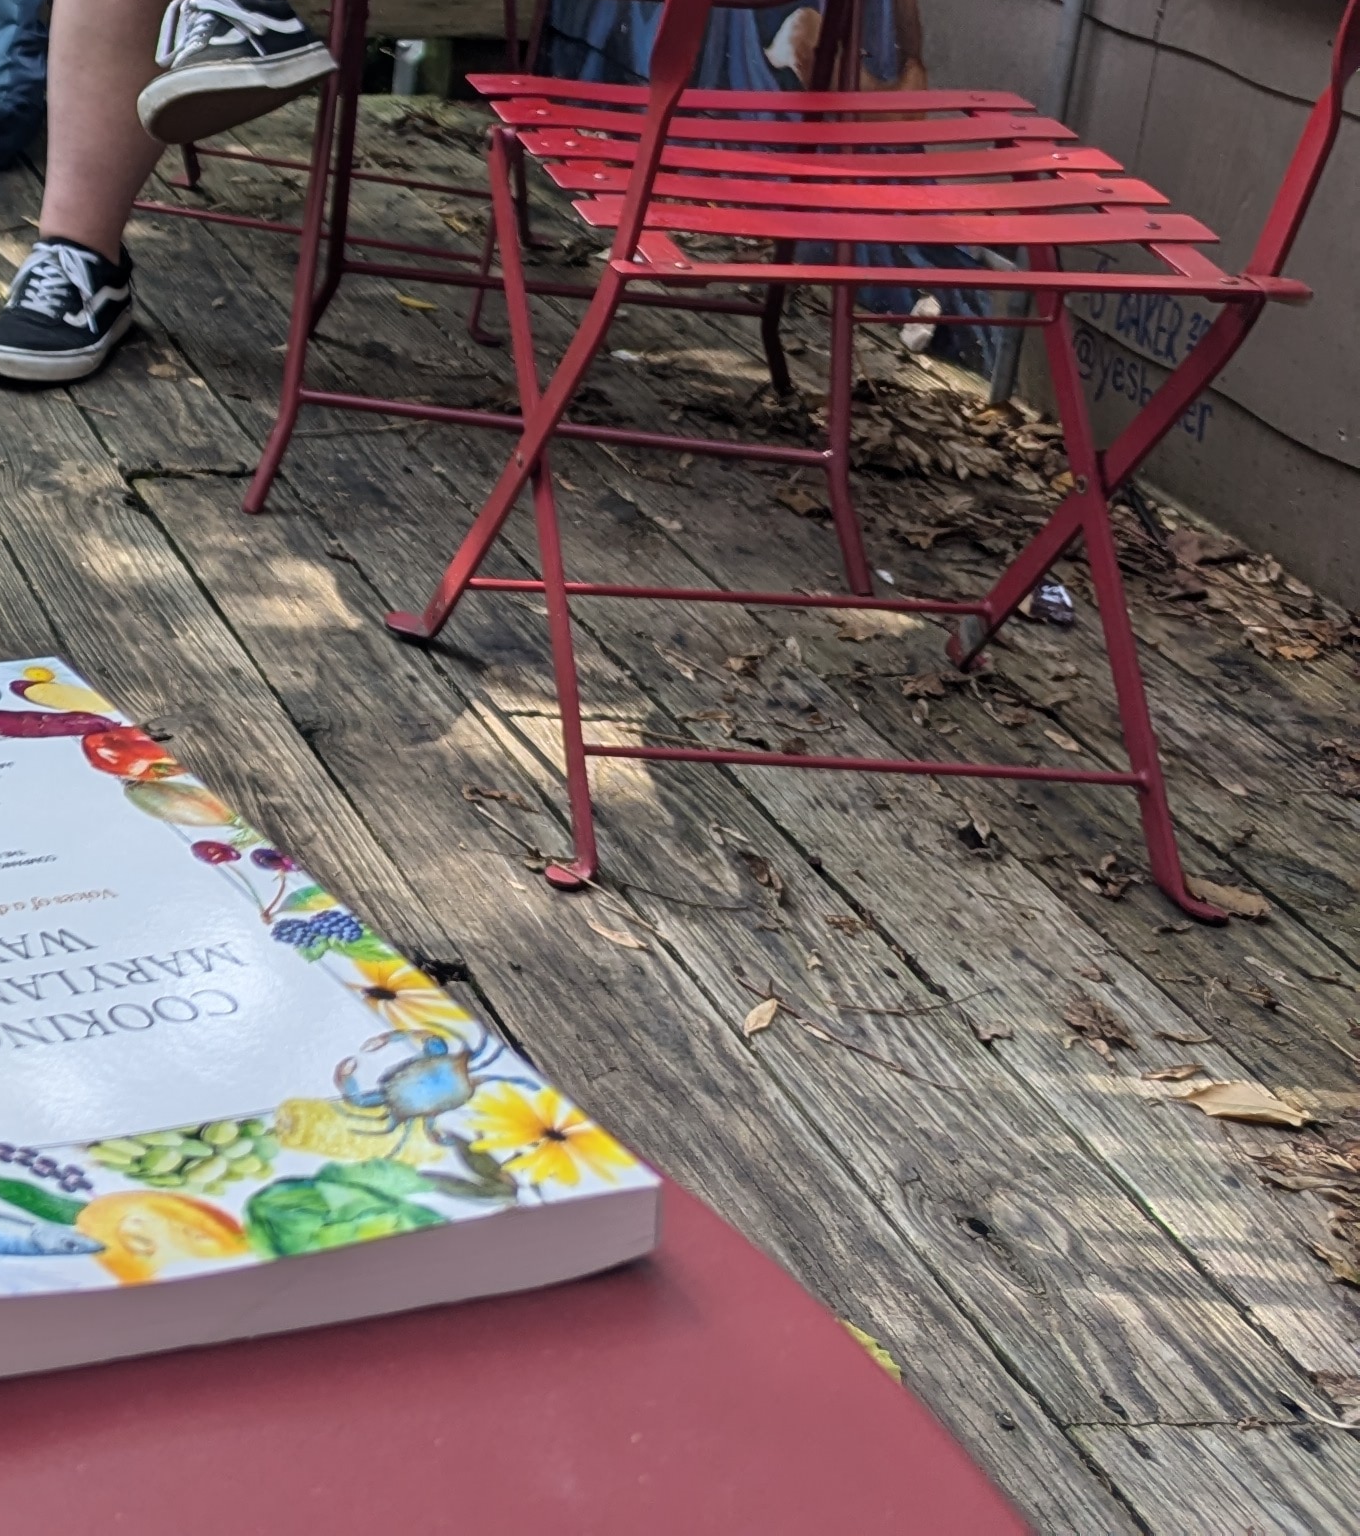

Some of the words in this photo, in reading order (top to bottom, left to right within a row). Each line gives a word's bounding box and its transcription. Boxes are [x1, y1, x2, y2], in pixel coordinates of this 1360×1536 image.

[31, 896, 51, 911] of
[53, 888, 119, 904] Voices
[12, 901, 26, 910] a
